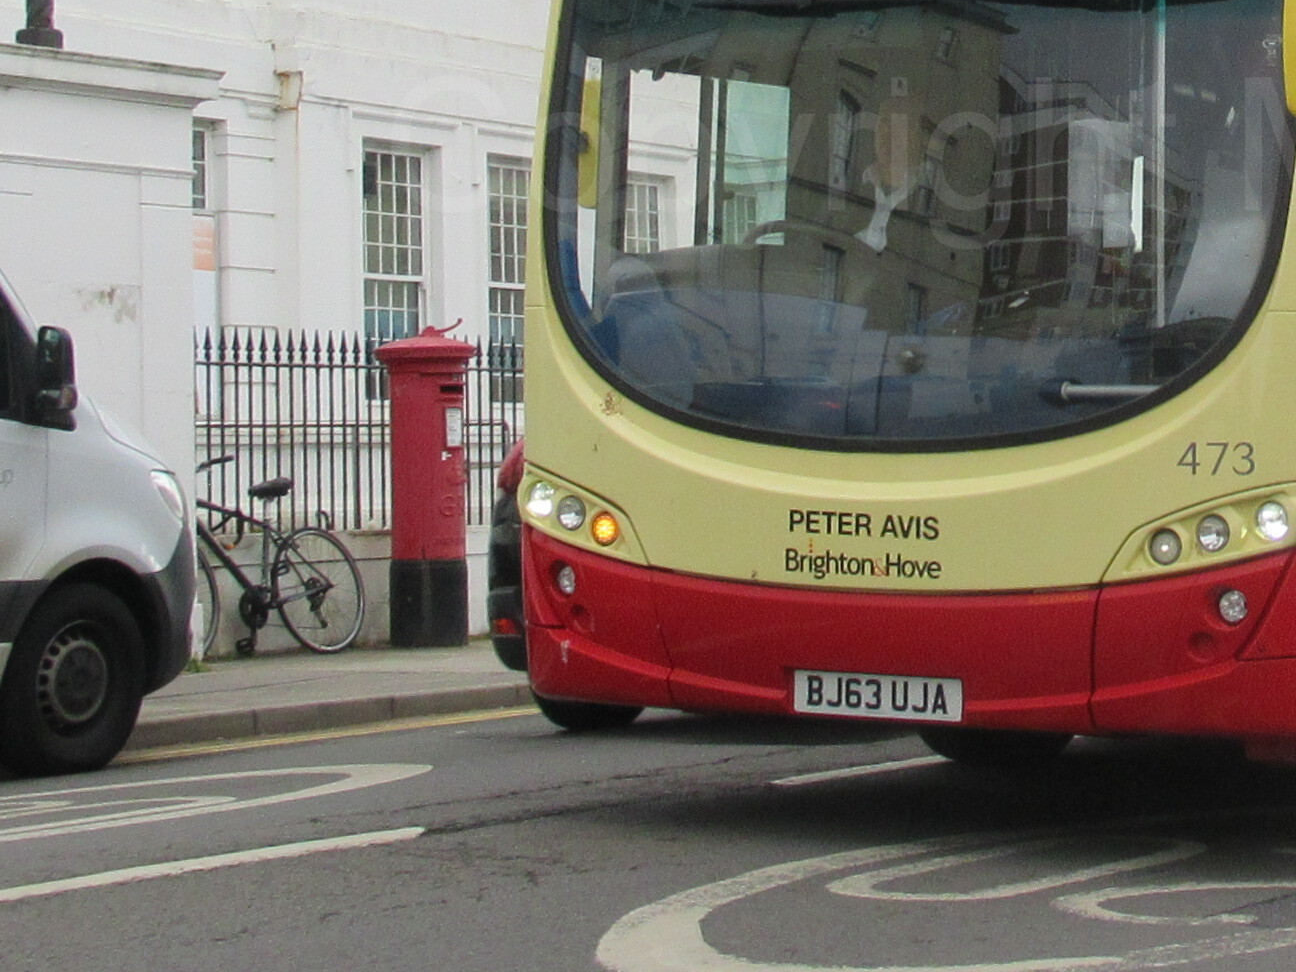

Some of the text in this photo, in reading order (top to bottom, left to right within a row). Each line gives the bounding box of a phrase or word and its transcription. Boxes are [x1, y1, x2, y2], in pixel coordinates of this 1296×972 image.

[1176, 441, 1257, 476] 473
[788, 509, 940, 541] PETER AVIS
[806, 675, 949, 716] BJ63 UJA
